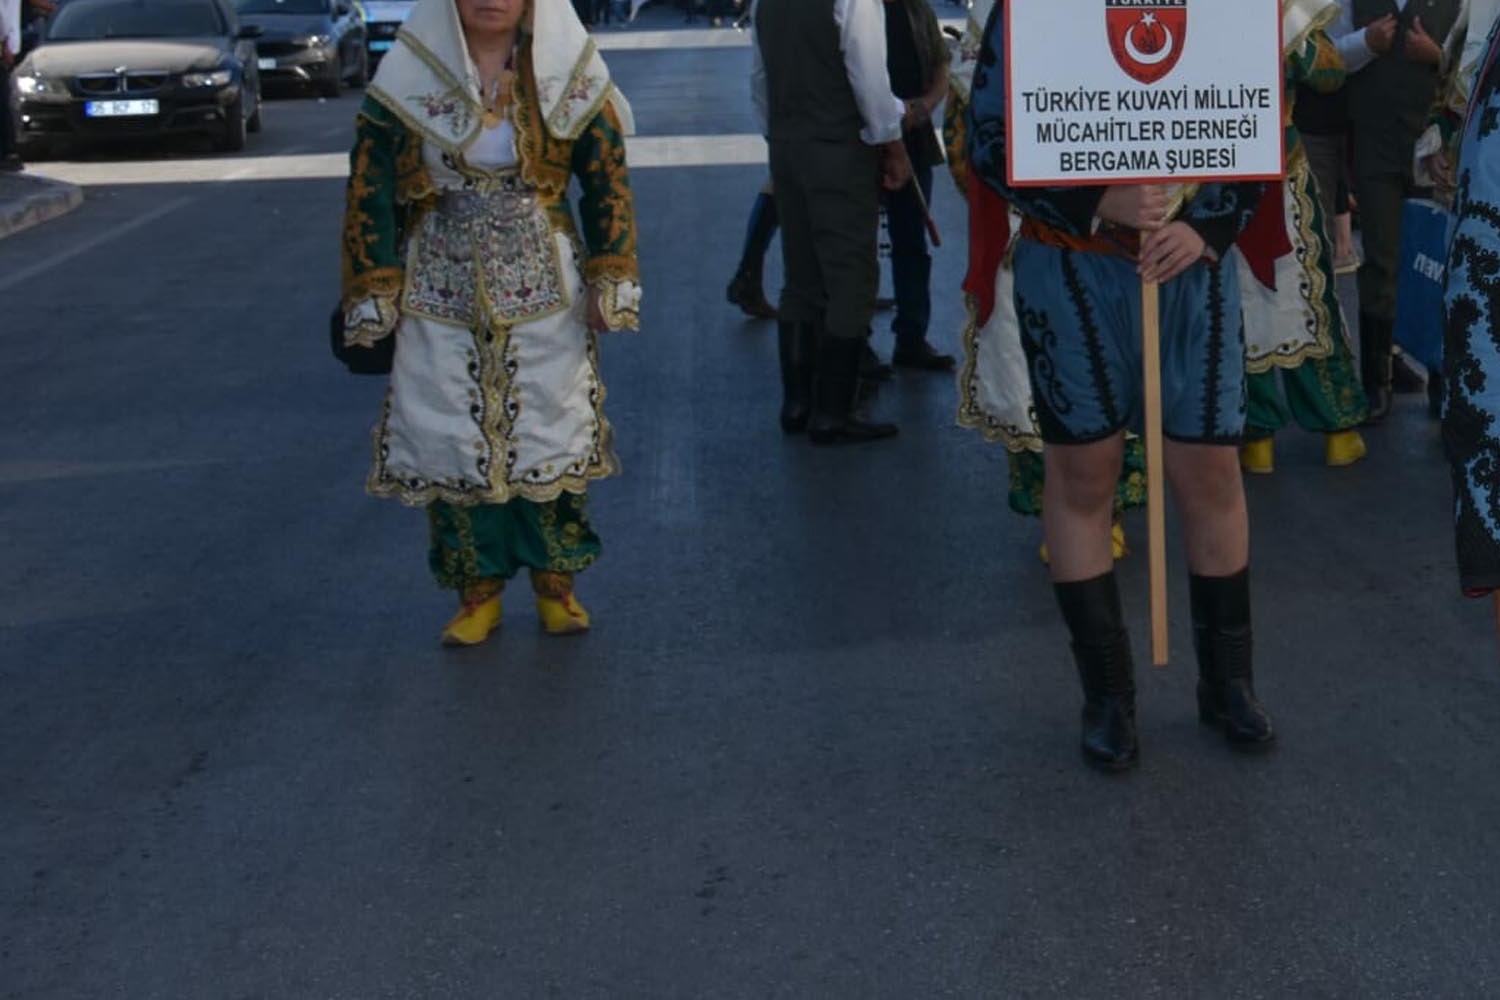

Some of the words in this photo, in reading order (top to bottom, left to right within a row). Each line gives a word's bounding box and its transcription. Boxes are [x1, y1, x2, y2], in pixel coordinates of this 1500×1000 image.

[1022, 86, 1111, 113] TÜRKİYE
[1117, 85, 1188, 111] KUVAYİ
[1194, 83, 1271, 110] MİLLİYE
[1036, 116, 1165, 143] MÜCAHİTLER
[1171, 114, 1257, 141] DERNEĞİ
[1060, 149, 1159, 172] BERGAMA
[1166, 143, 1236, 174] ŞUBESİ
